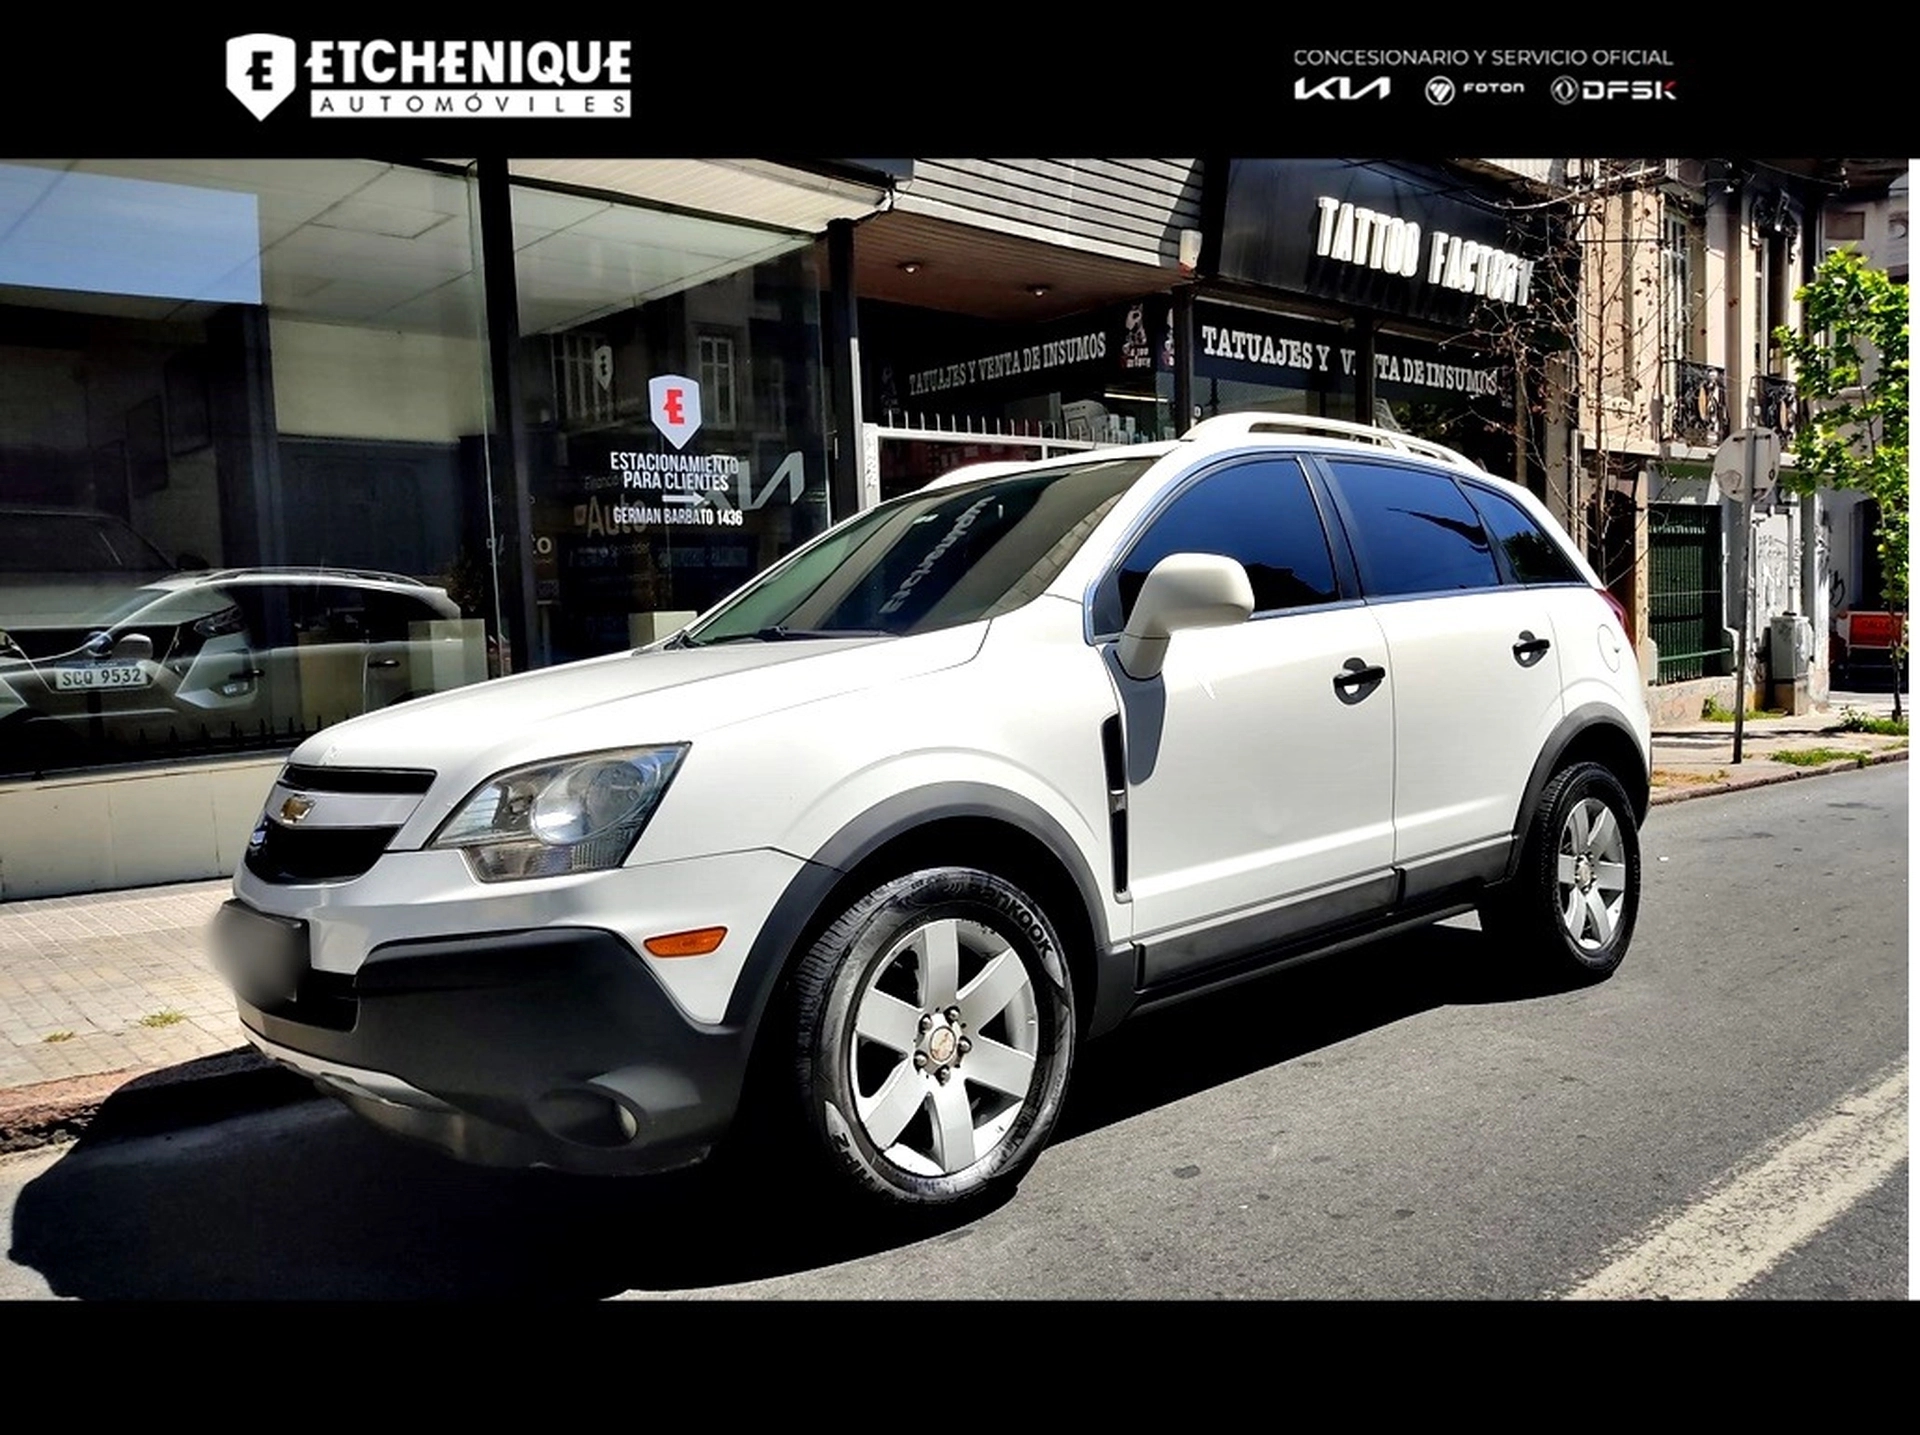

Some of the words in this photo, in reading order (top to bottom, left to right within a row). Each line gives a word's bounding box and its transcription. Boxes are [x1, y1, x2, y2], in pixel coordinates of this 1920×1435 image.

[1316, 196, 1421, 277] TATTOO
[1427, 231, 1535, 307] FACTORY
[909, 363, 967, 396] TATUAJES
[967, 360, 977, 383] Y
[978, 350, 1021, 381] VENTA
[1023, 345, 1041, 372] DE
[1042, 331, 1106, 369] INSUMOS
[1202, 325, 1312, 370] TATUAJES
[1316, 344, 1330, 371] Y
[1340, 348, 1400, 382] VTA
[1403, 357, 1424, 385] DE
[1426, 362, 1498, 396] INSUMOS
[610, 451, 740, 474] ESTACIONAMIENTO
[623, 470, 662, 489] PARA
[664, 472, 729, 491] CLIENTES
[613, 506, 661, 525] GERMAN
[663, 508, 714, 525] BARBATO
[717, 508, 744, 526] 1436
[101, 668, 142, 684] 9532
